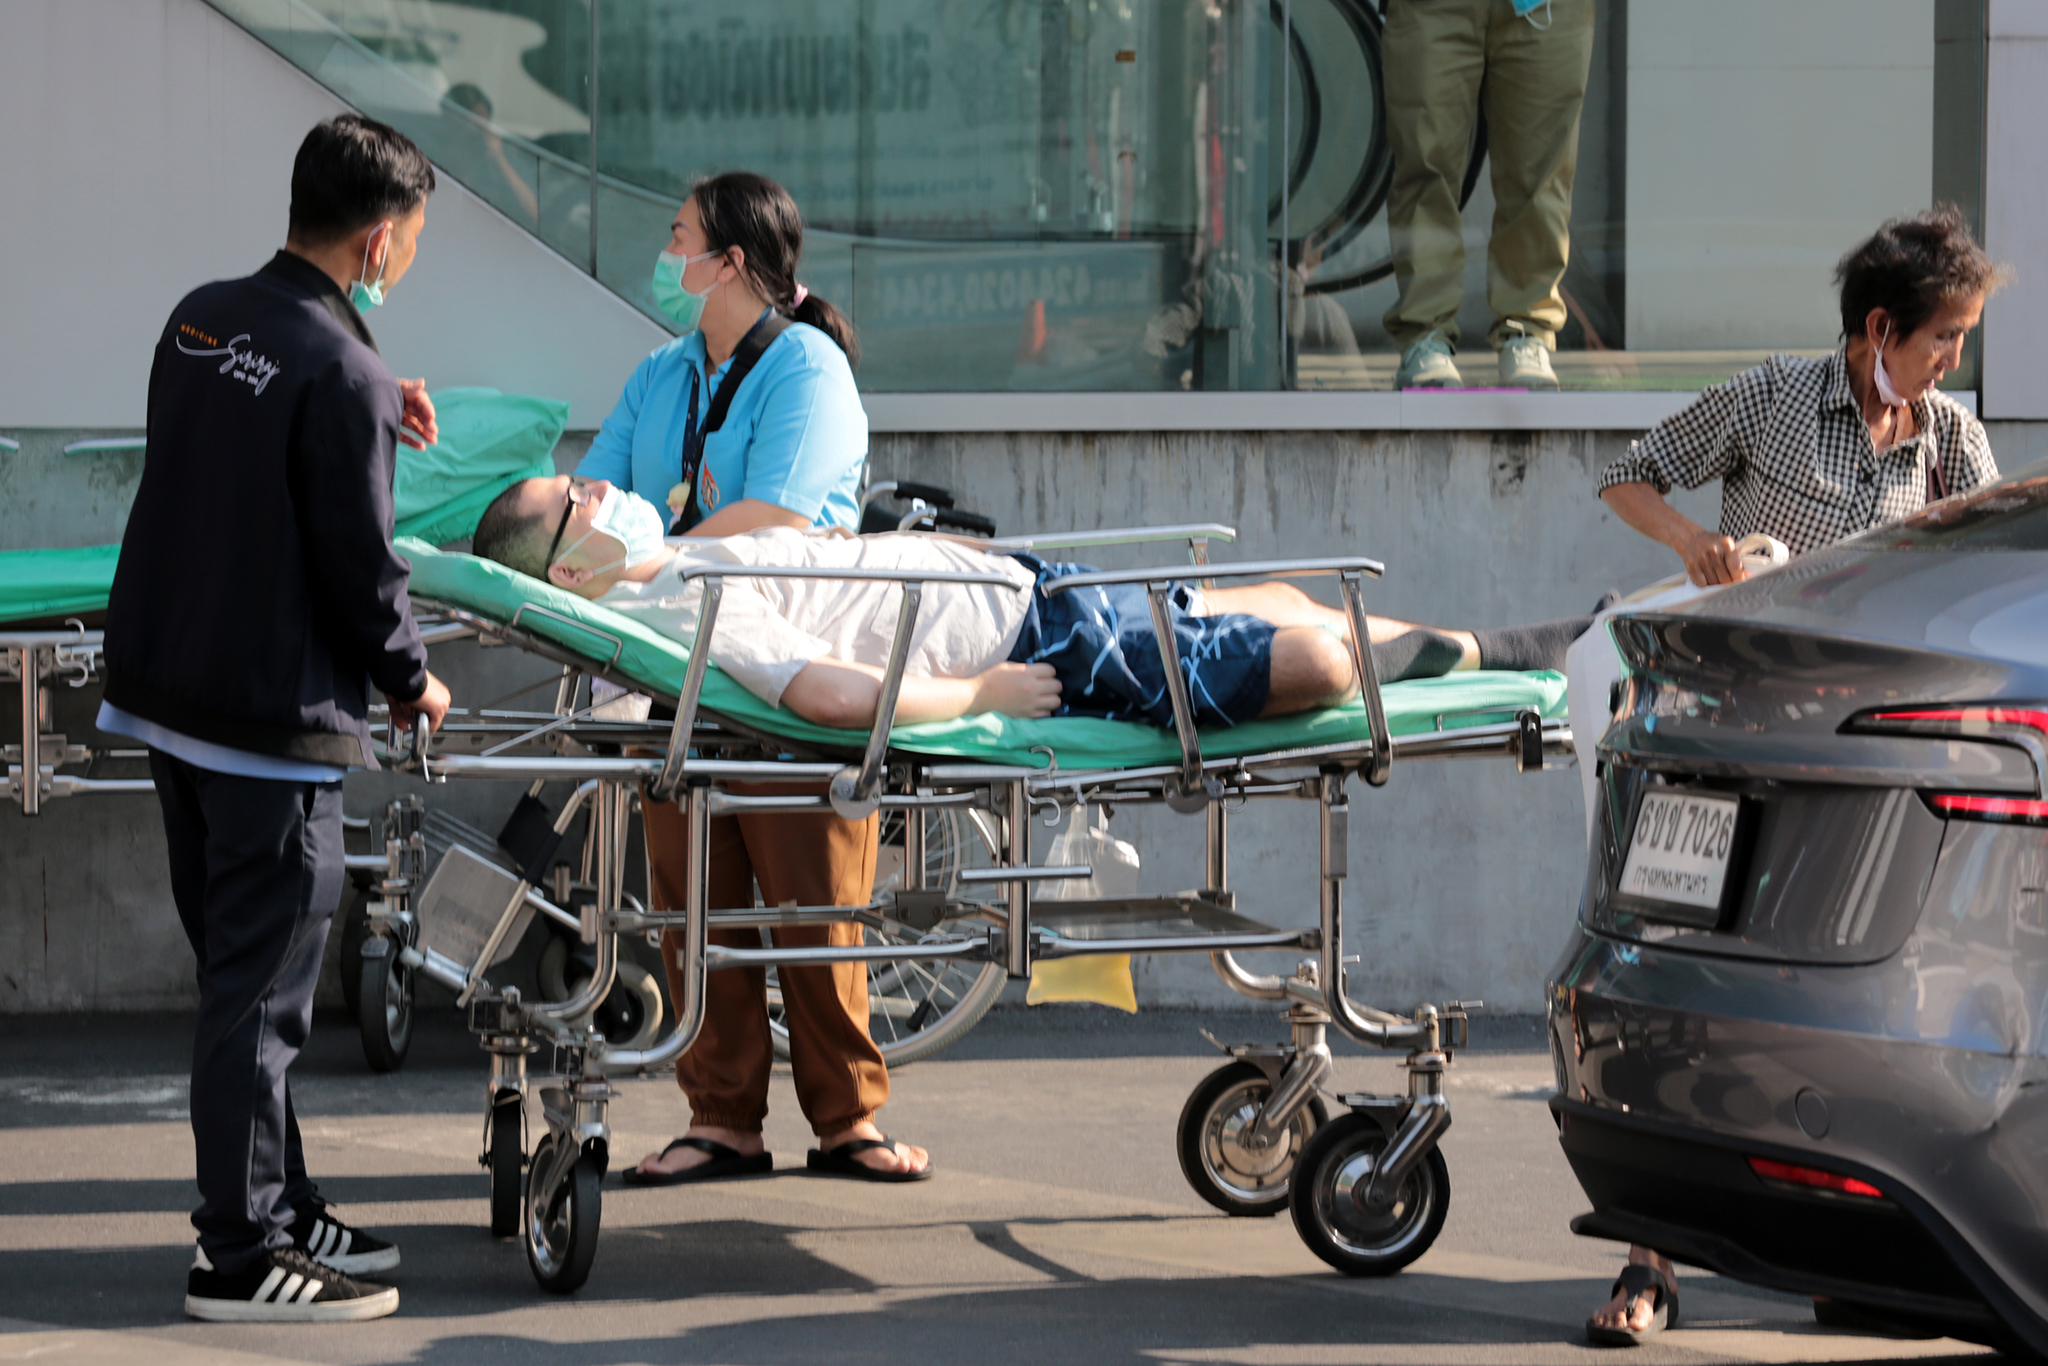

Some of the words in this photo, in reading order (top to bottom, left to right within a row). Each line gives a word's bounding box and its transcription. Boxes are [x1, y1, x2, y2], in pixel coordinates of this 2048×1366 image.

[180, 323, 218, 347] MEDICINE
[1680, 804, 1732, 860] 7026
[1634, 864, 1709, 895] กรุงเทพมหานคร
